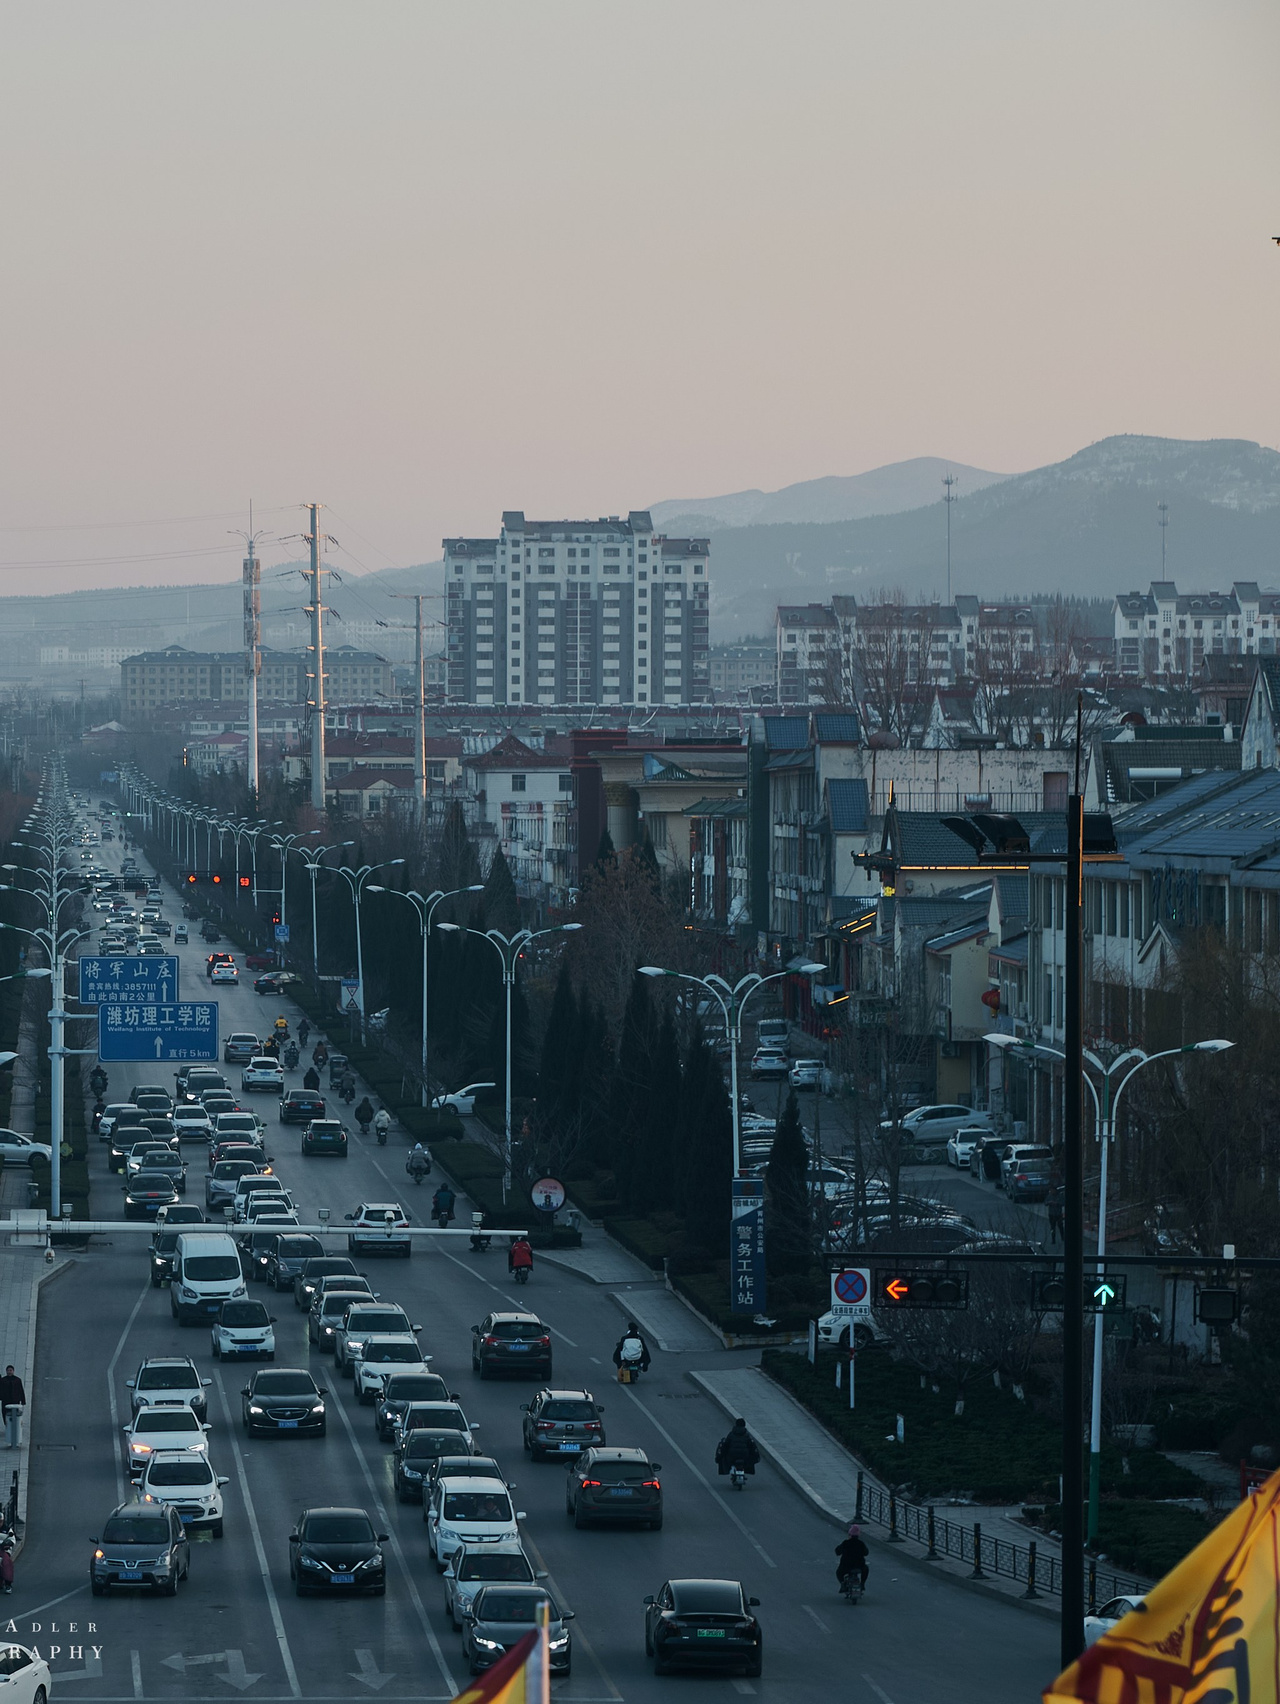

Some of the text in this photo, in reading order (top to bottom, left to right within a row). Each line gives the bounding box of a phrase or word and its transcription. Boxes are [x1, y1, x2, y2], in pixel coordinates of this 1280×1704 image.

[85, 960, 173, 980] 将军山庄
[88, 992, 156, 1002] 由此向南2公里
[107, 1006, 211, 1026] 潍坊理工学院
[168, 1048, 188, 1058] 直行
[736, 1225, 754, 1306] 警务工作站
